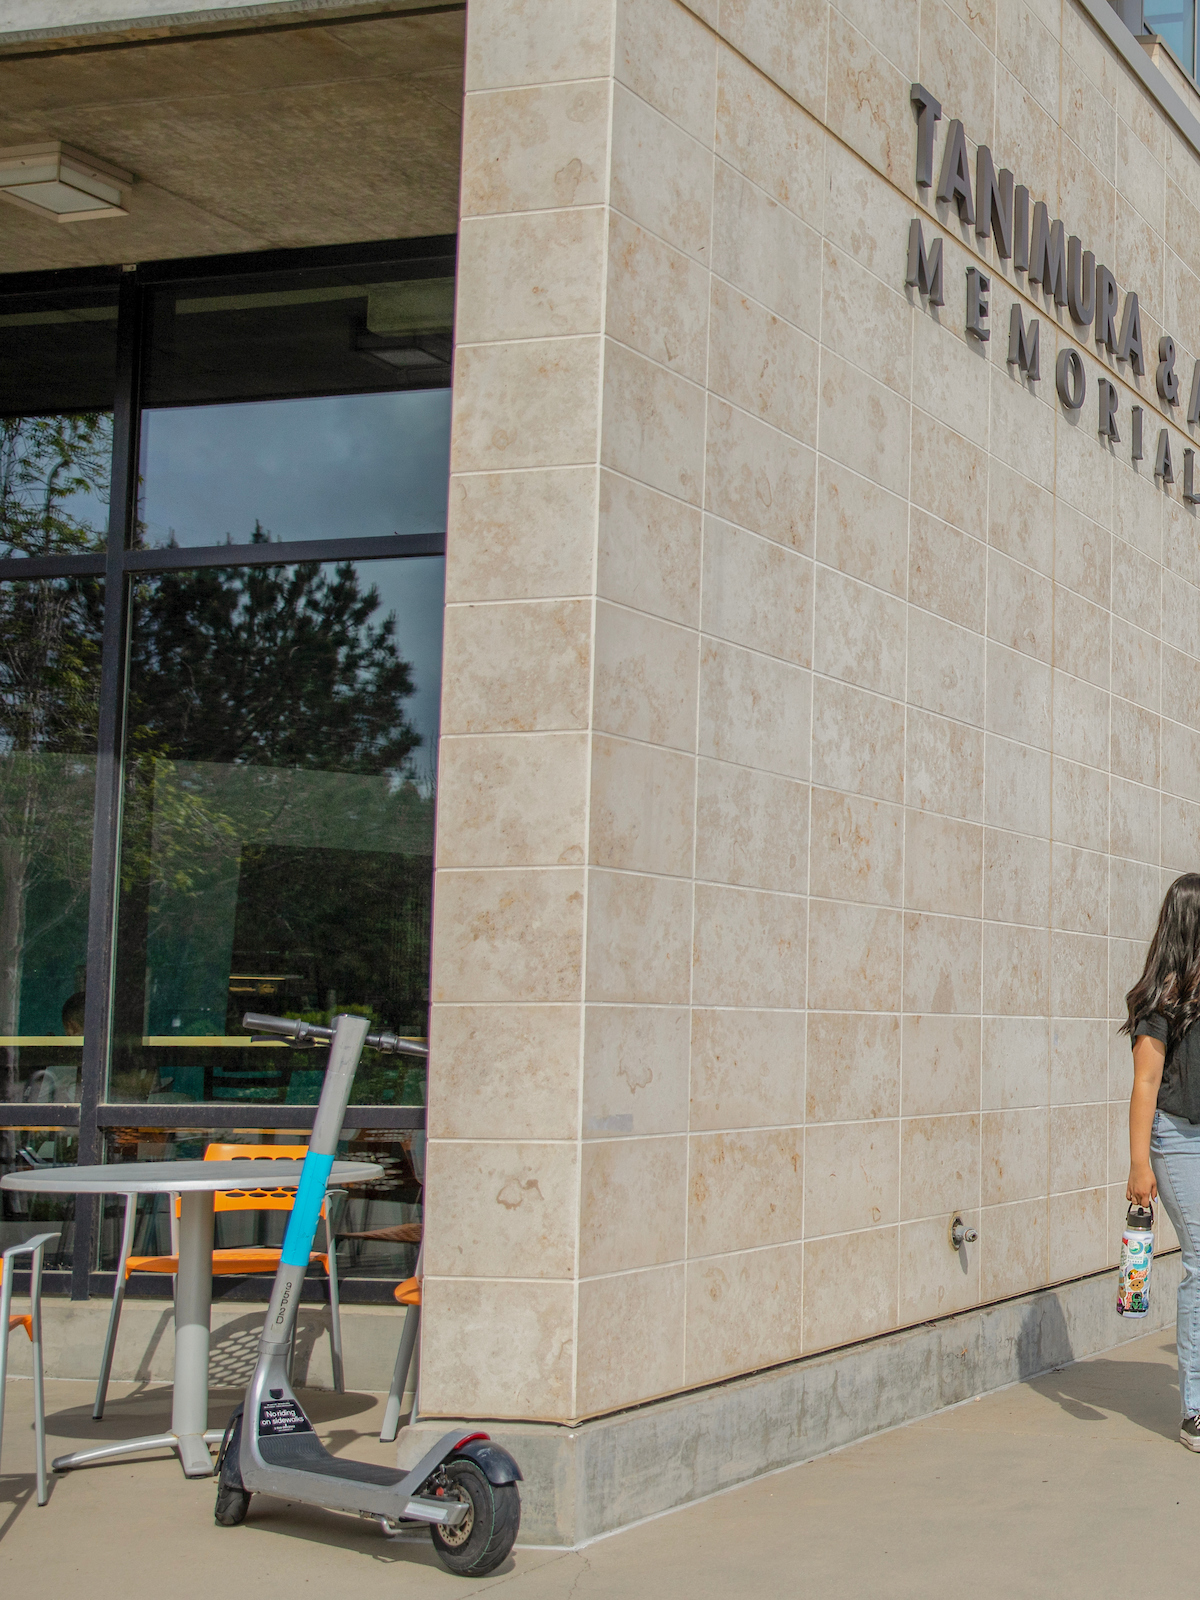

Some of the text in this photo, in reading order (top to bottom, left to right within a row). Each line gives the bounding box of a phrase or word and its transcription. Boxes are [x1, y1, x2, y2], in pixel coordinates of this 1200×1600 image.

[910, 83, 1145, 376] TANIMURA
[1156, 336, 1180, 407] &
[272, 1416, 304, 1424] sidewalks
